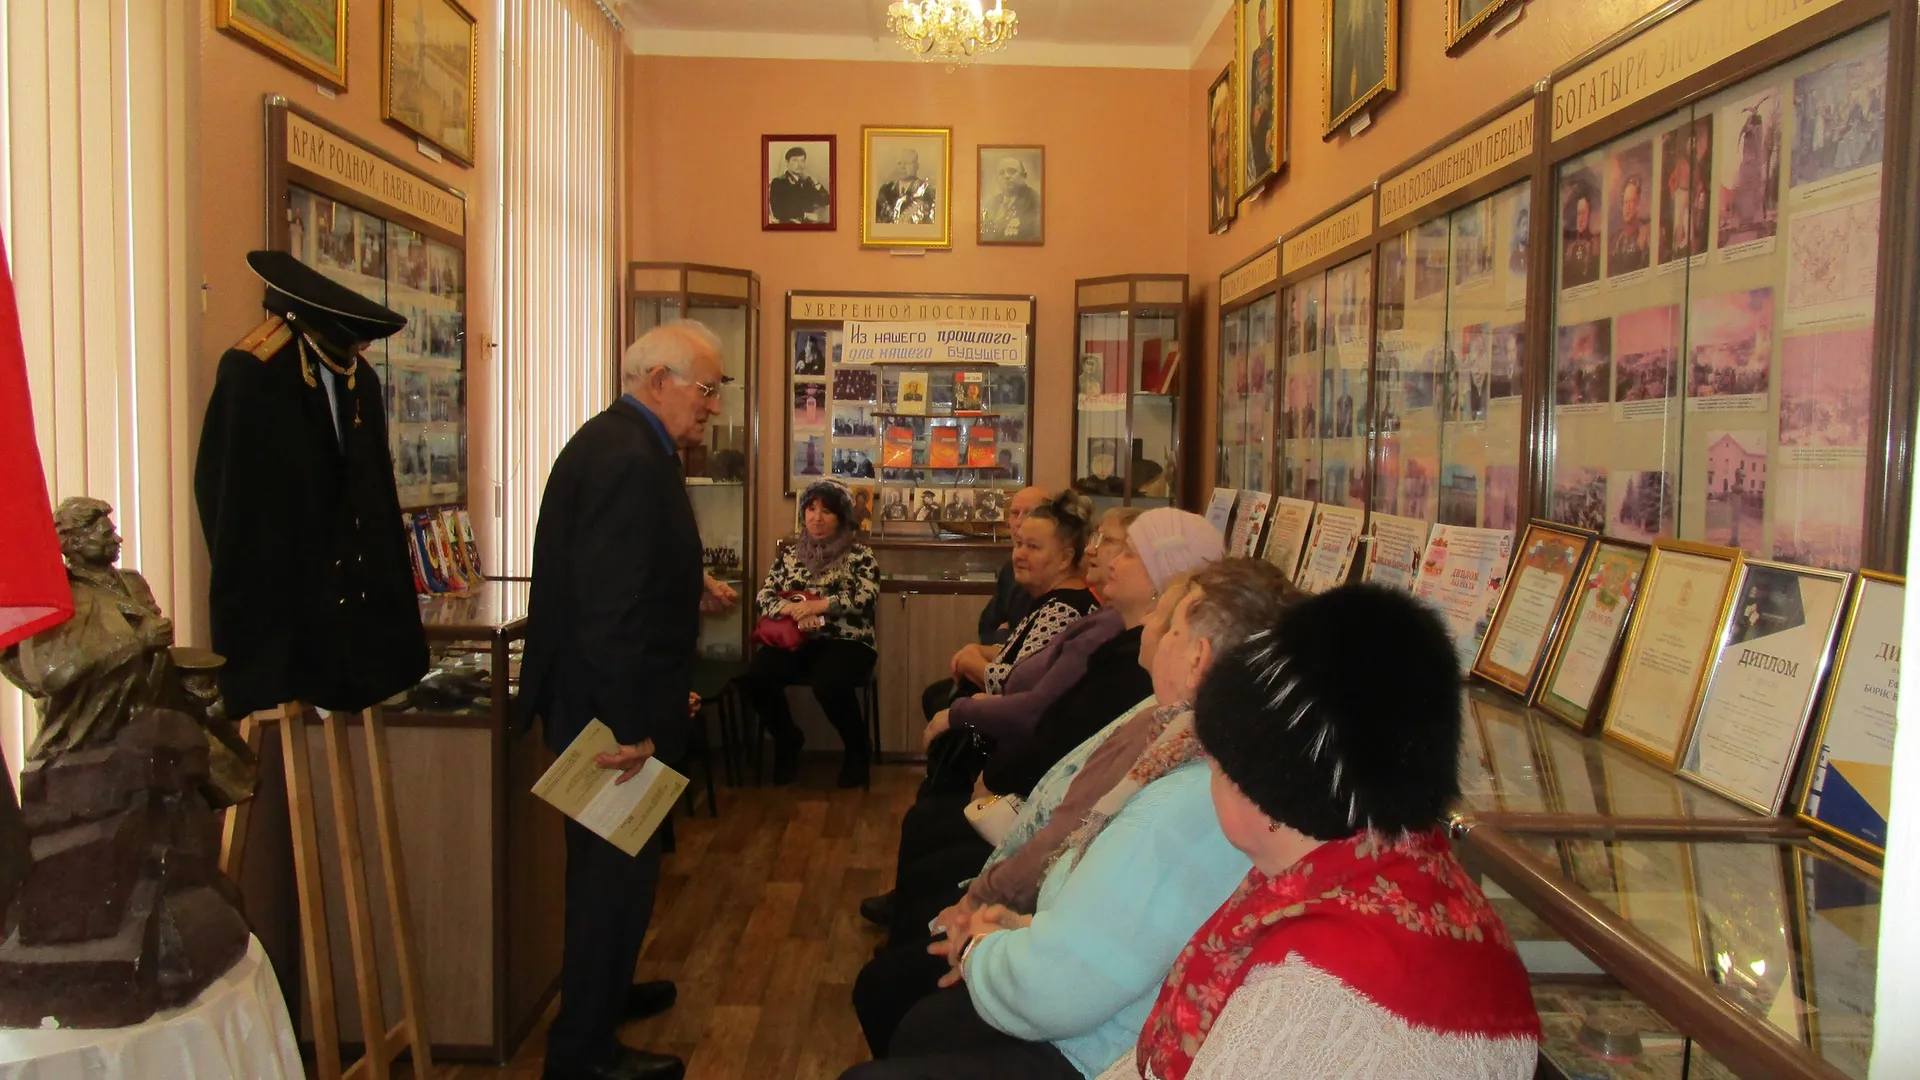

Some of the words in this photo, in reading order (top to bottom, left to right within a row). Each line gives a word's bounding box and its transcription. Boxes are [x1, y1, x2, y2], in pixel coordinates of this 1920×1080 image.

[1555, 47, 1648, 130] БОГАТЫРИ
[293, 126, 325, 168] КРАЙ
[383, 171, 414, 206] НАВЕК
[1381, 181, 1407, 217] ХВАЛА
[1408, 141, 1483, 204] ВОЗВЫШЕННЫМ
[1485, 113, 1534, 166] ПЕВЦАМ
[804, 301, 911, 319] УВЕРЕННОЙ
[919, 304, 1017, 322] ПОСТУПЬЮ
[850, 324, 867, 344] Из
[1738, 648, 1799, 678] ДИПЛОМ
[1864, 684, 1892, 700] БОРИС
